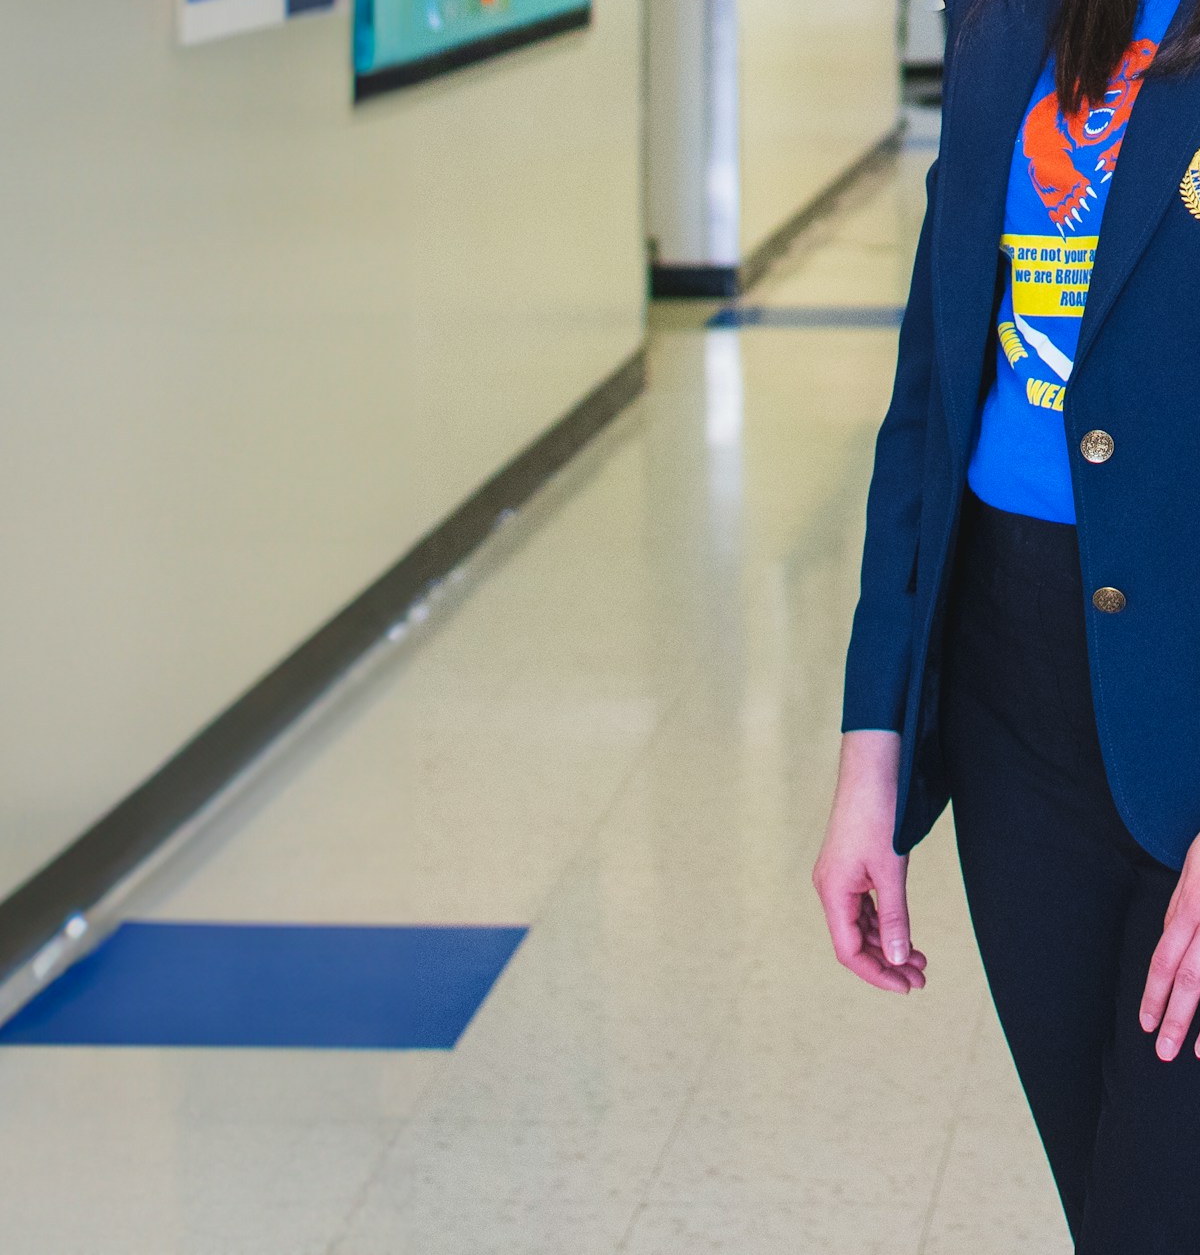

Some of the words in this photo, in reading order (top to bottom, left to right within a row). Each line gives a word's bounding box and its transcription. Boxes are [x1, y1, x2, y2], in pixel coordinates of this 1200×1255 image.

[1018, 248, 1037, 261] are
[1040, 248, 1061, 262] not
[1064, 249, 1088, 264] your
[1015, 269, 1031, 282] we
[1034, 270, 1052, 283] are
